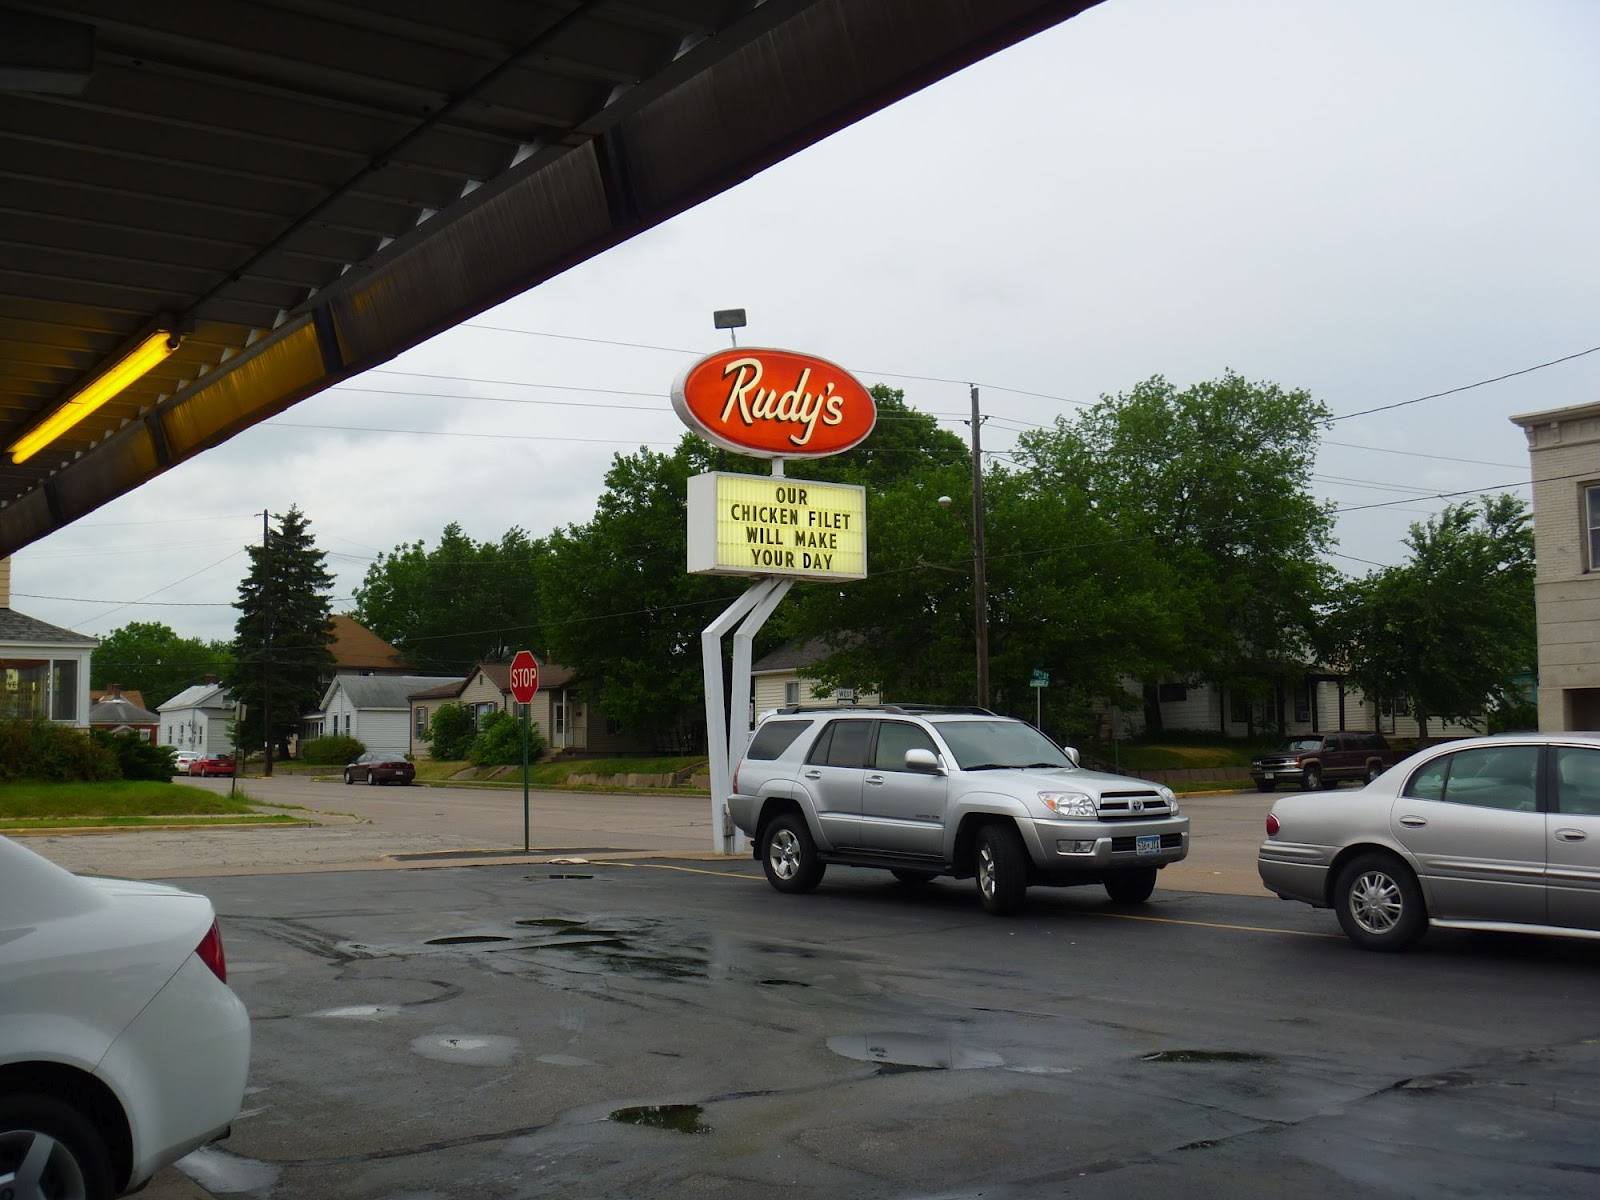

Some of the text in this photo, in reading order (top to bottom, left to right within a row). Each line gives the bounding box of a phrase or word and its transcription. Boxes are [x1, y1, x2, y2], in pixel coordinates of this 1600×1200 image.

[721, 358, 844, 446] Rudy's
[776, 487, 808, 505] OUR
[730, 503, 850, 529] CHICKEN FILET
[746, 526, 837, 549] WILL MAKE
[751, 548, 833, 570] YOUR DAY
[512, 668, 537, 688] STOP
[838, 690, 853, 698] WEST
